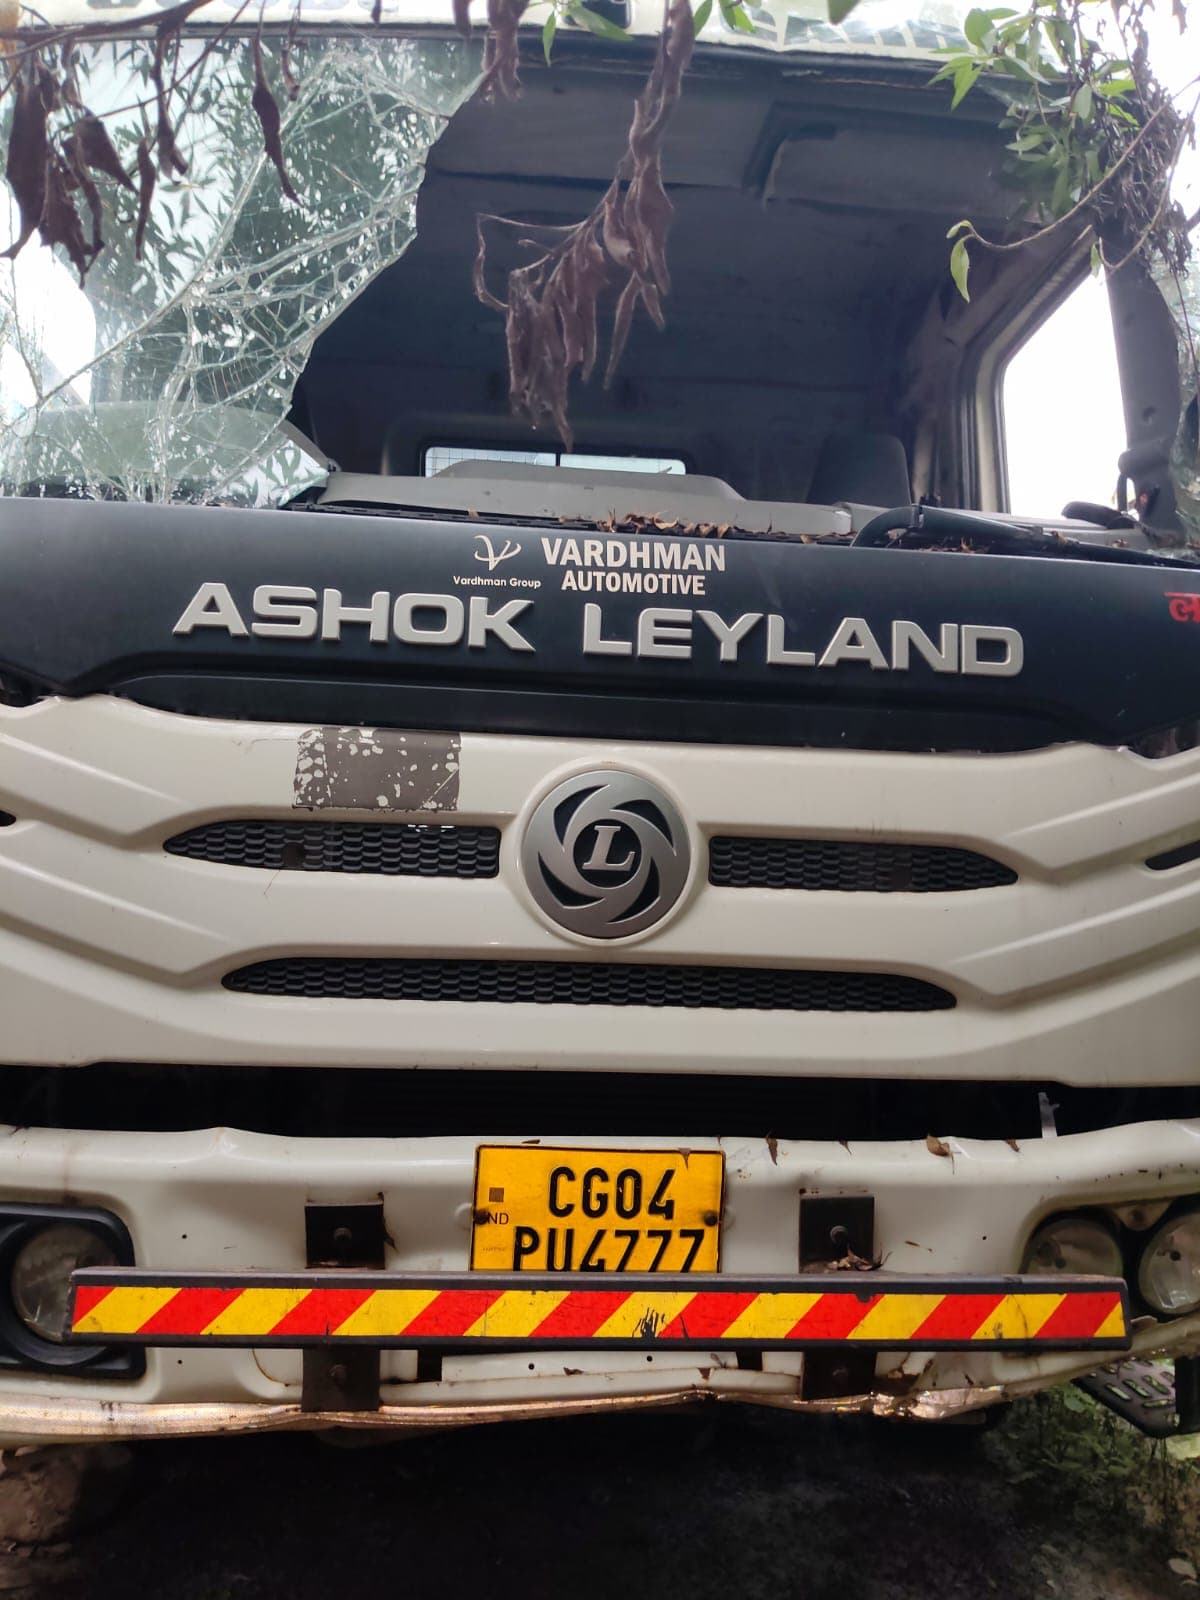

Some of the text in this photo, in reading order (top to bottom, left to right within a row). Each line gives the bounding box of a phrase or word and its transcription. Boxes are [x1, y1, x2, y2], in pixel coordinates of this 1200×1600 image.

[540, 537, 726, 571] VARDHMAN
[453, 575, 542, 589] Vardhman Group
[560, 570, 706, 596] AUTOMOTIVE
[172, 582, 1025, 677] ASHOK LEYLAND
[549, 1166, 676, 1220] CG04
[483, 1211, 510, 1226] ND
[512, 1226, 706, 1273] PU4777
